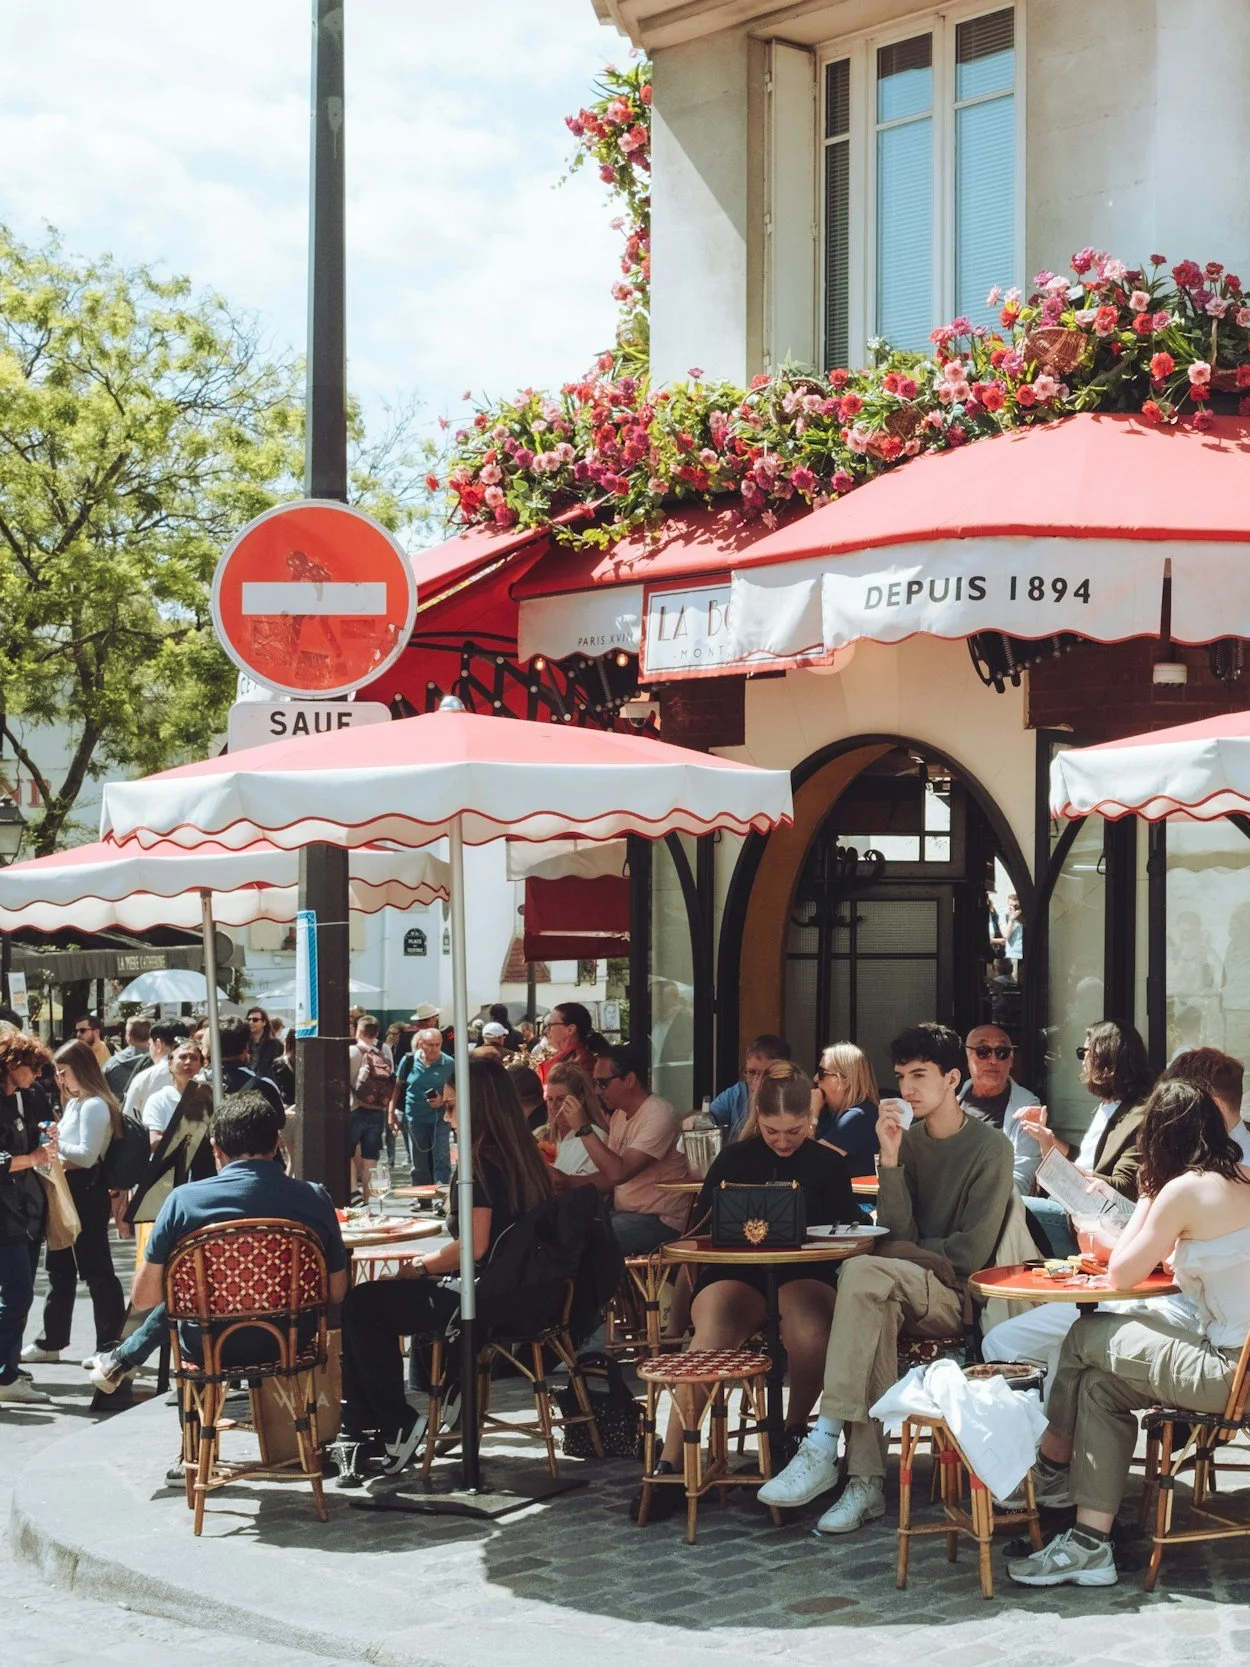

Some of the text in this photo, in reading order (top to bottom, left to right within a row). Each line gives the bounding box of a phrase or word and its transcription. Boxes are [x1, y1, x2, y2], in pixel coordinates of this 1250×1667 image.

[864, 575, 1092, 611] DEPUIS 1894
[577, 635, 606, 647] PARIS
[657, 605, 689, 641] LA
